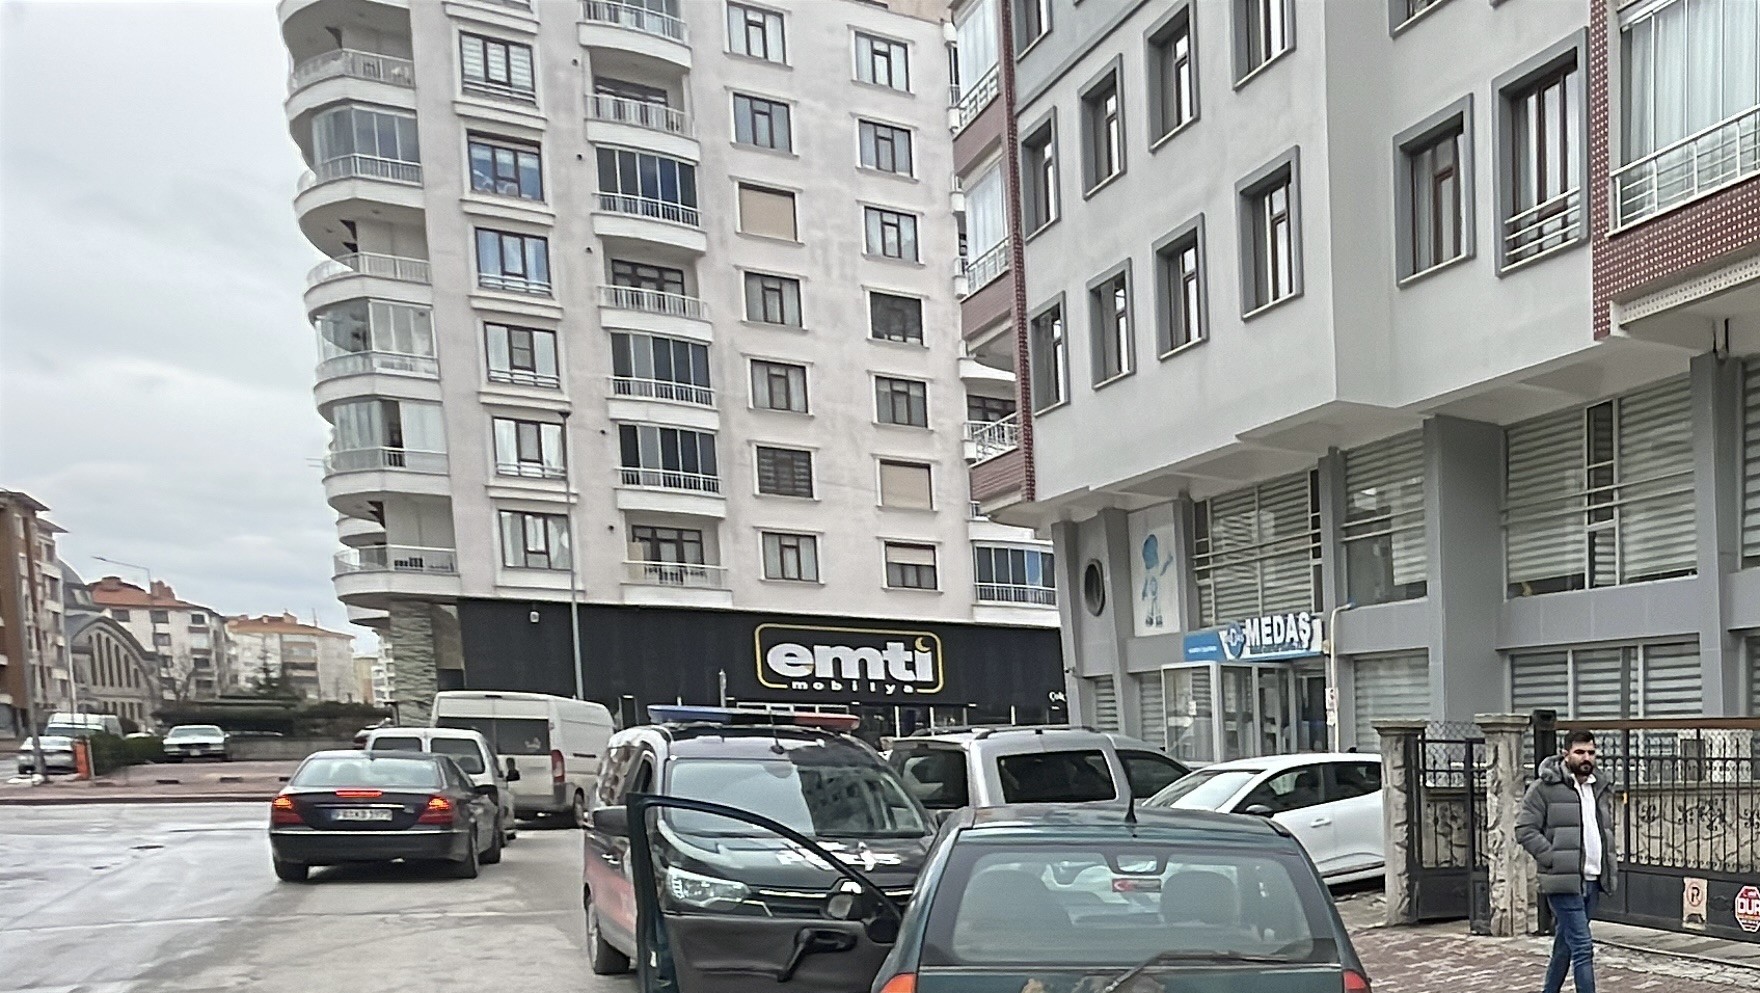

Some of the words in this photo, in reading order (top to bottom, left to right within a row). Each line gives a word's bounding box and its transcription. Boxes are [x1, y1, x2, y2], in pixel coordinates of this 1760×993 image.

[1245, 611, 1311, 649] MEDAŞ
[766, 637, 935, 682] emti
[791, 680, 915, 695] mobilya
[1738, 898, 1760, 915] DUR
